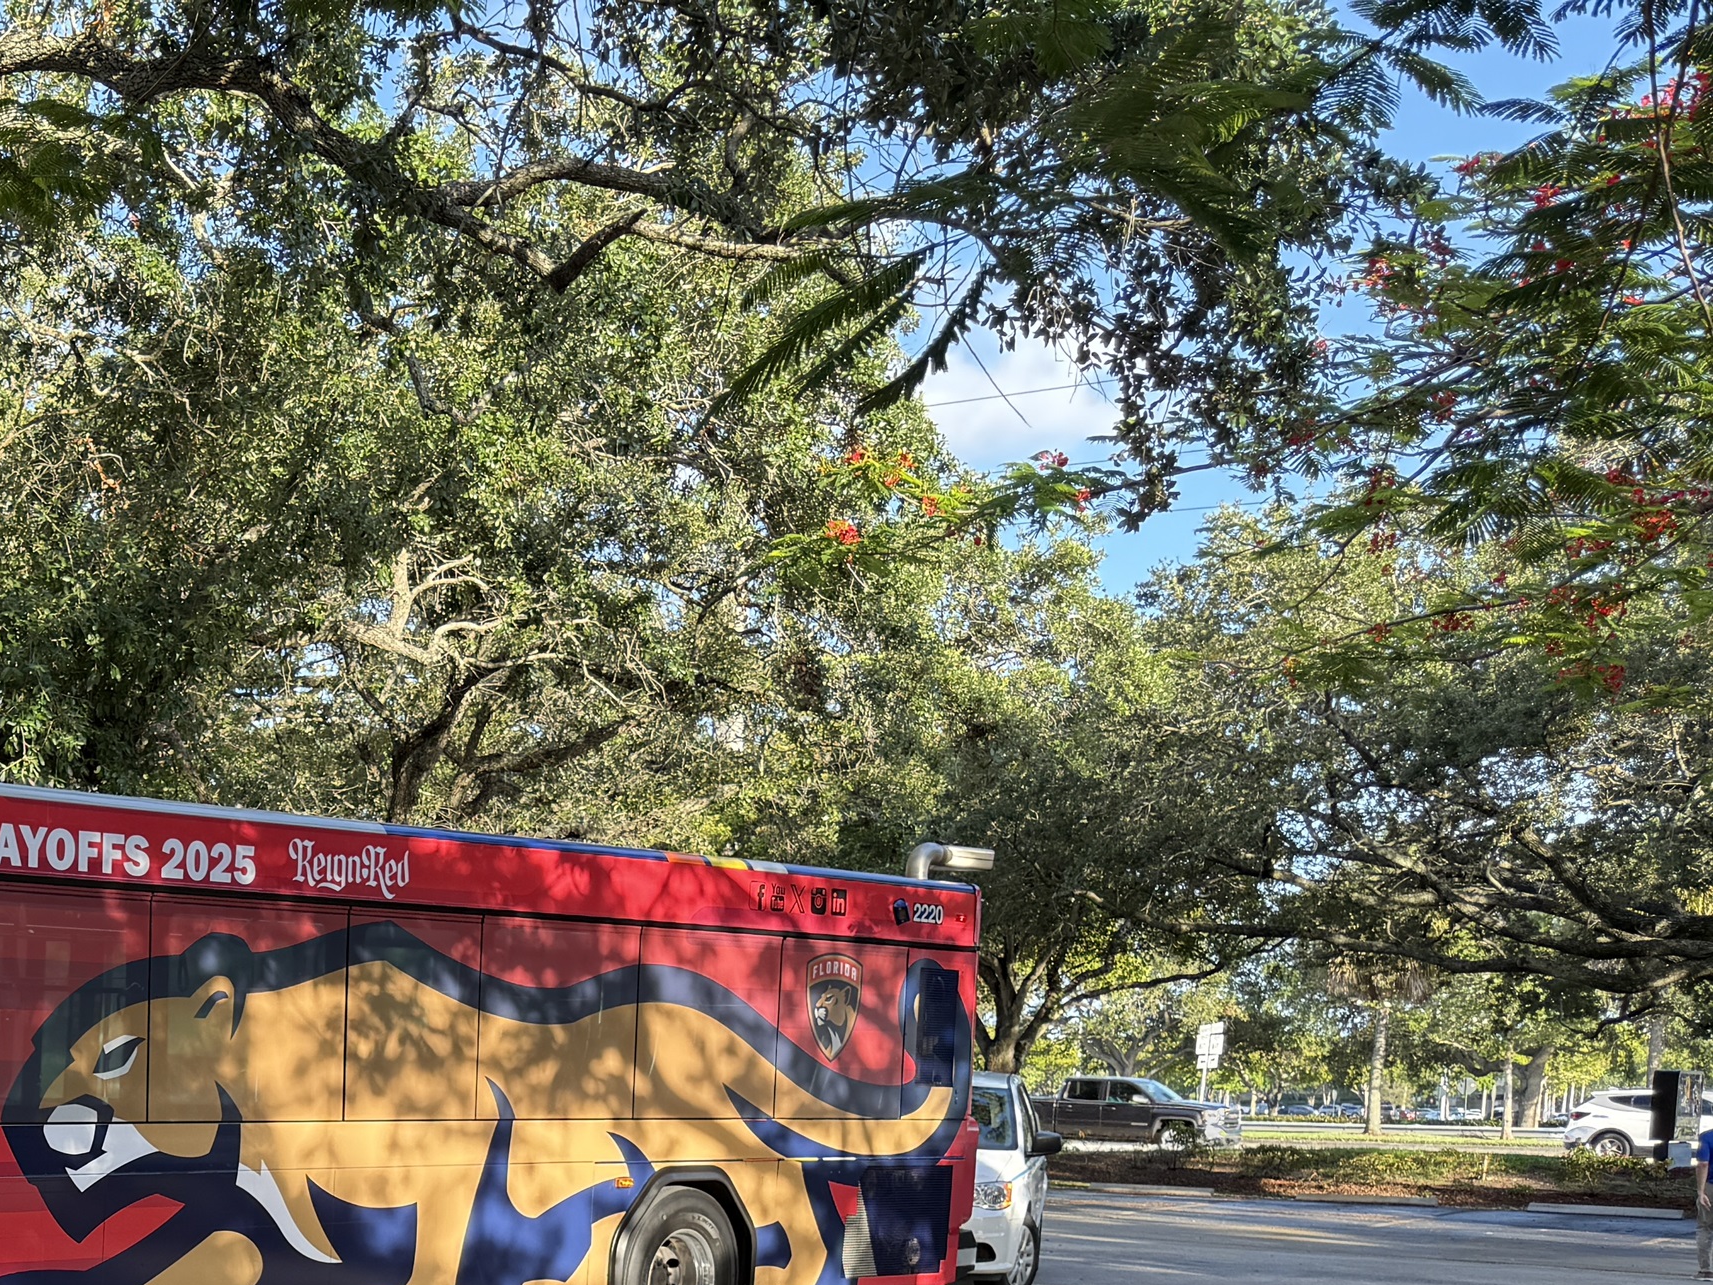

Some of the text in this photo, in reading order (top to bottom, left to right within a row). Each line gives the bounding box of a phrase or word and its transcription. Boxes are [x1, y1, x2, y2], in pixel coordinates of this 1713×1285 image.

[160, 837, 256, 885] 2025
[913, 903, 944, 925] 2220
[812, 961, 857, 981] FLORIDA
